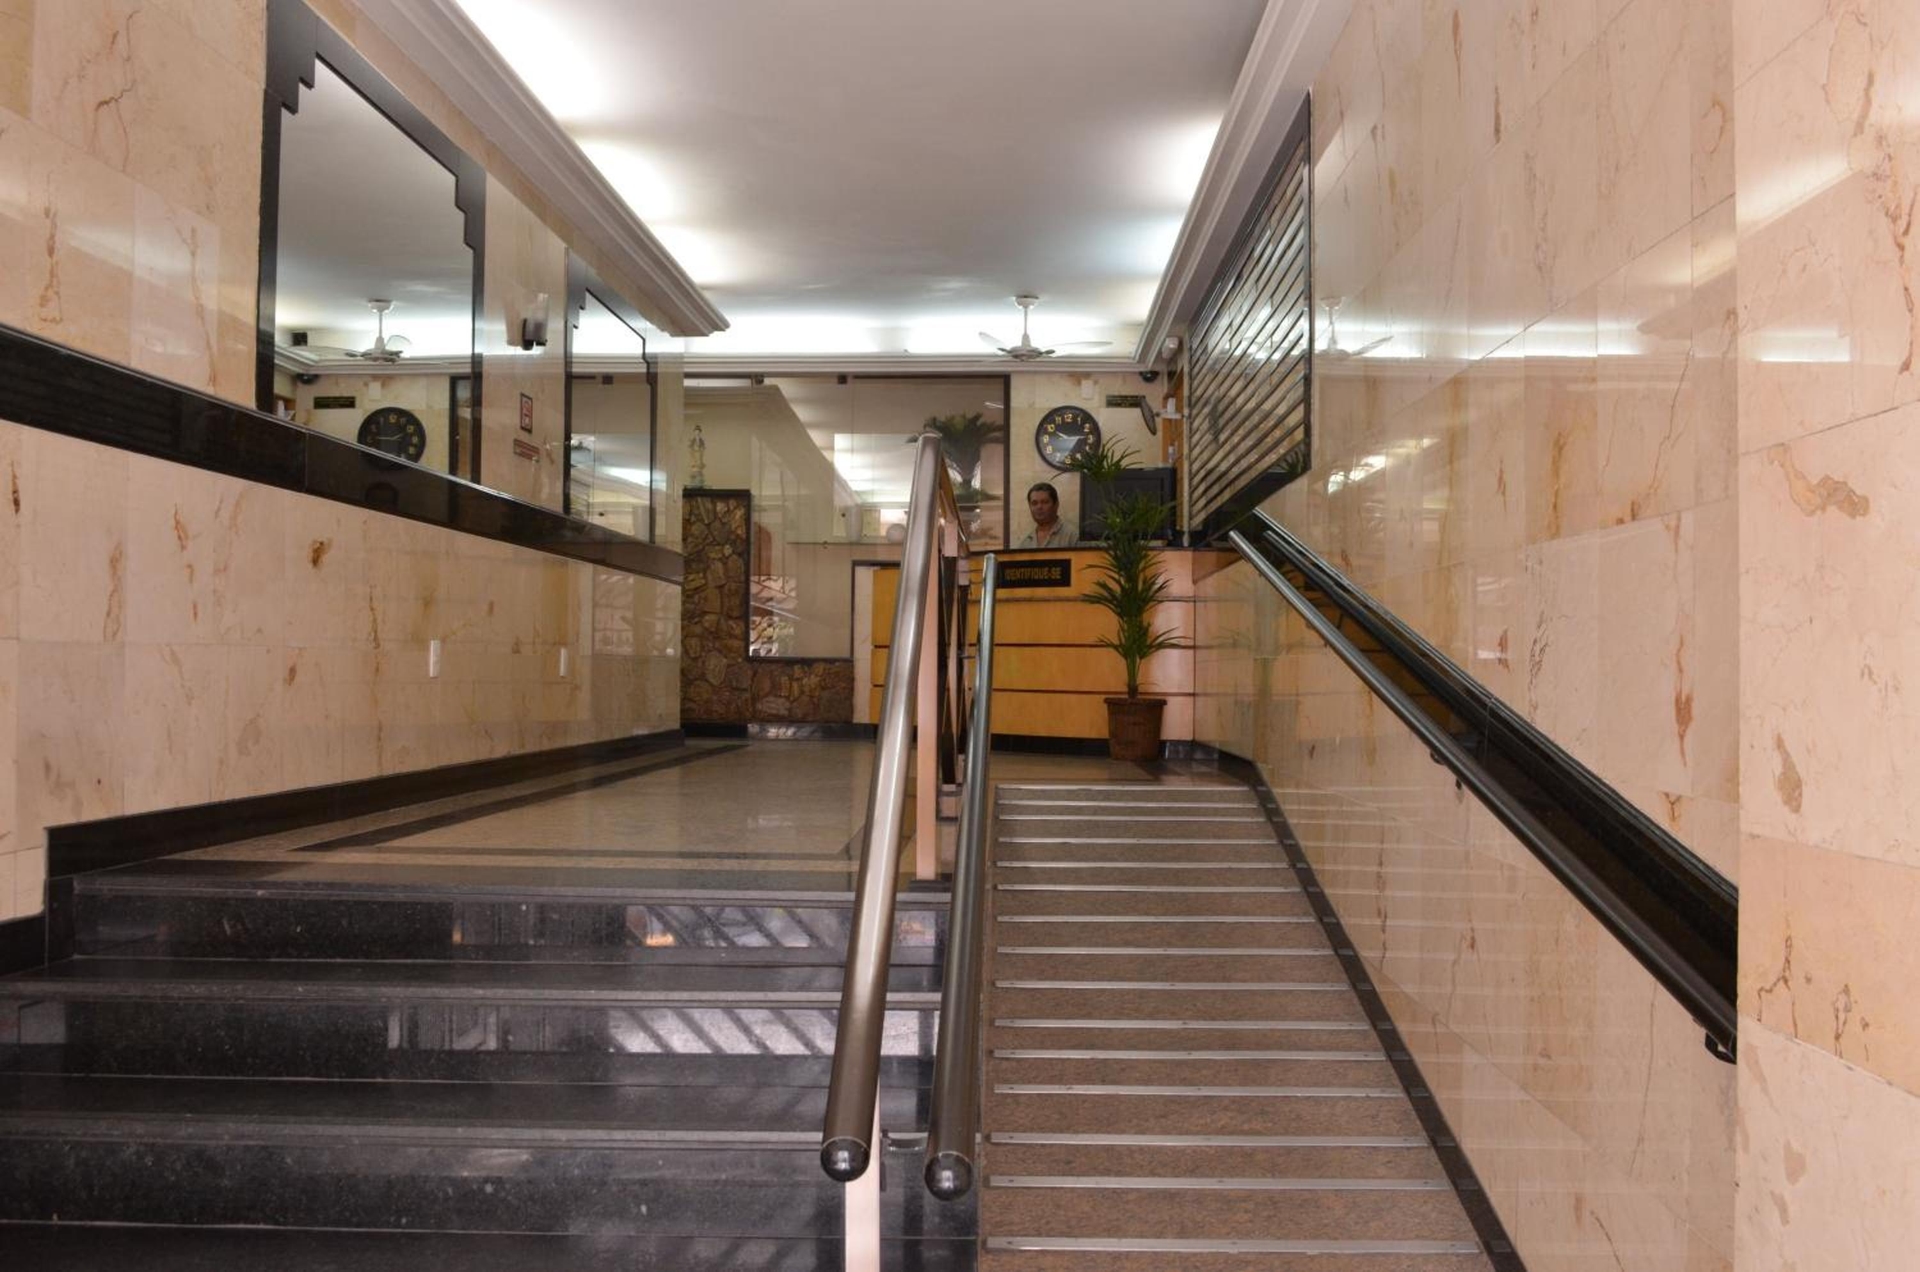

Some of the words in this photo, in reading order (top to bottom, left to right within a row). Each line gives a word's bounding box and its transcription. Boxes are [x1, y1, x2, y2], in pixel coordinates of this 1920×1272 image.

[1064, 413, 1073, 423] 12
[1044, 423, 1055, 433] 10
[1083, 423, 1090, 432] 2
[1043, 434, 1049, 443] 9
[1087, 434, 1093, 443] 3
